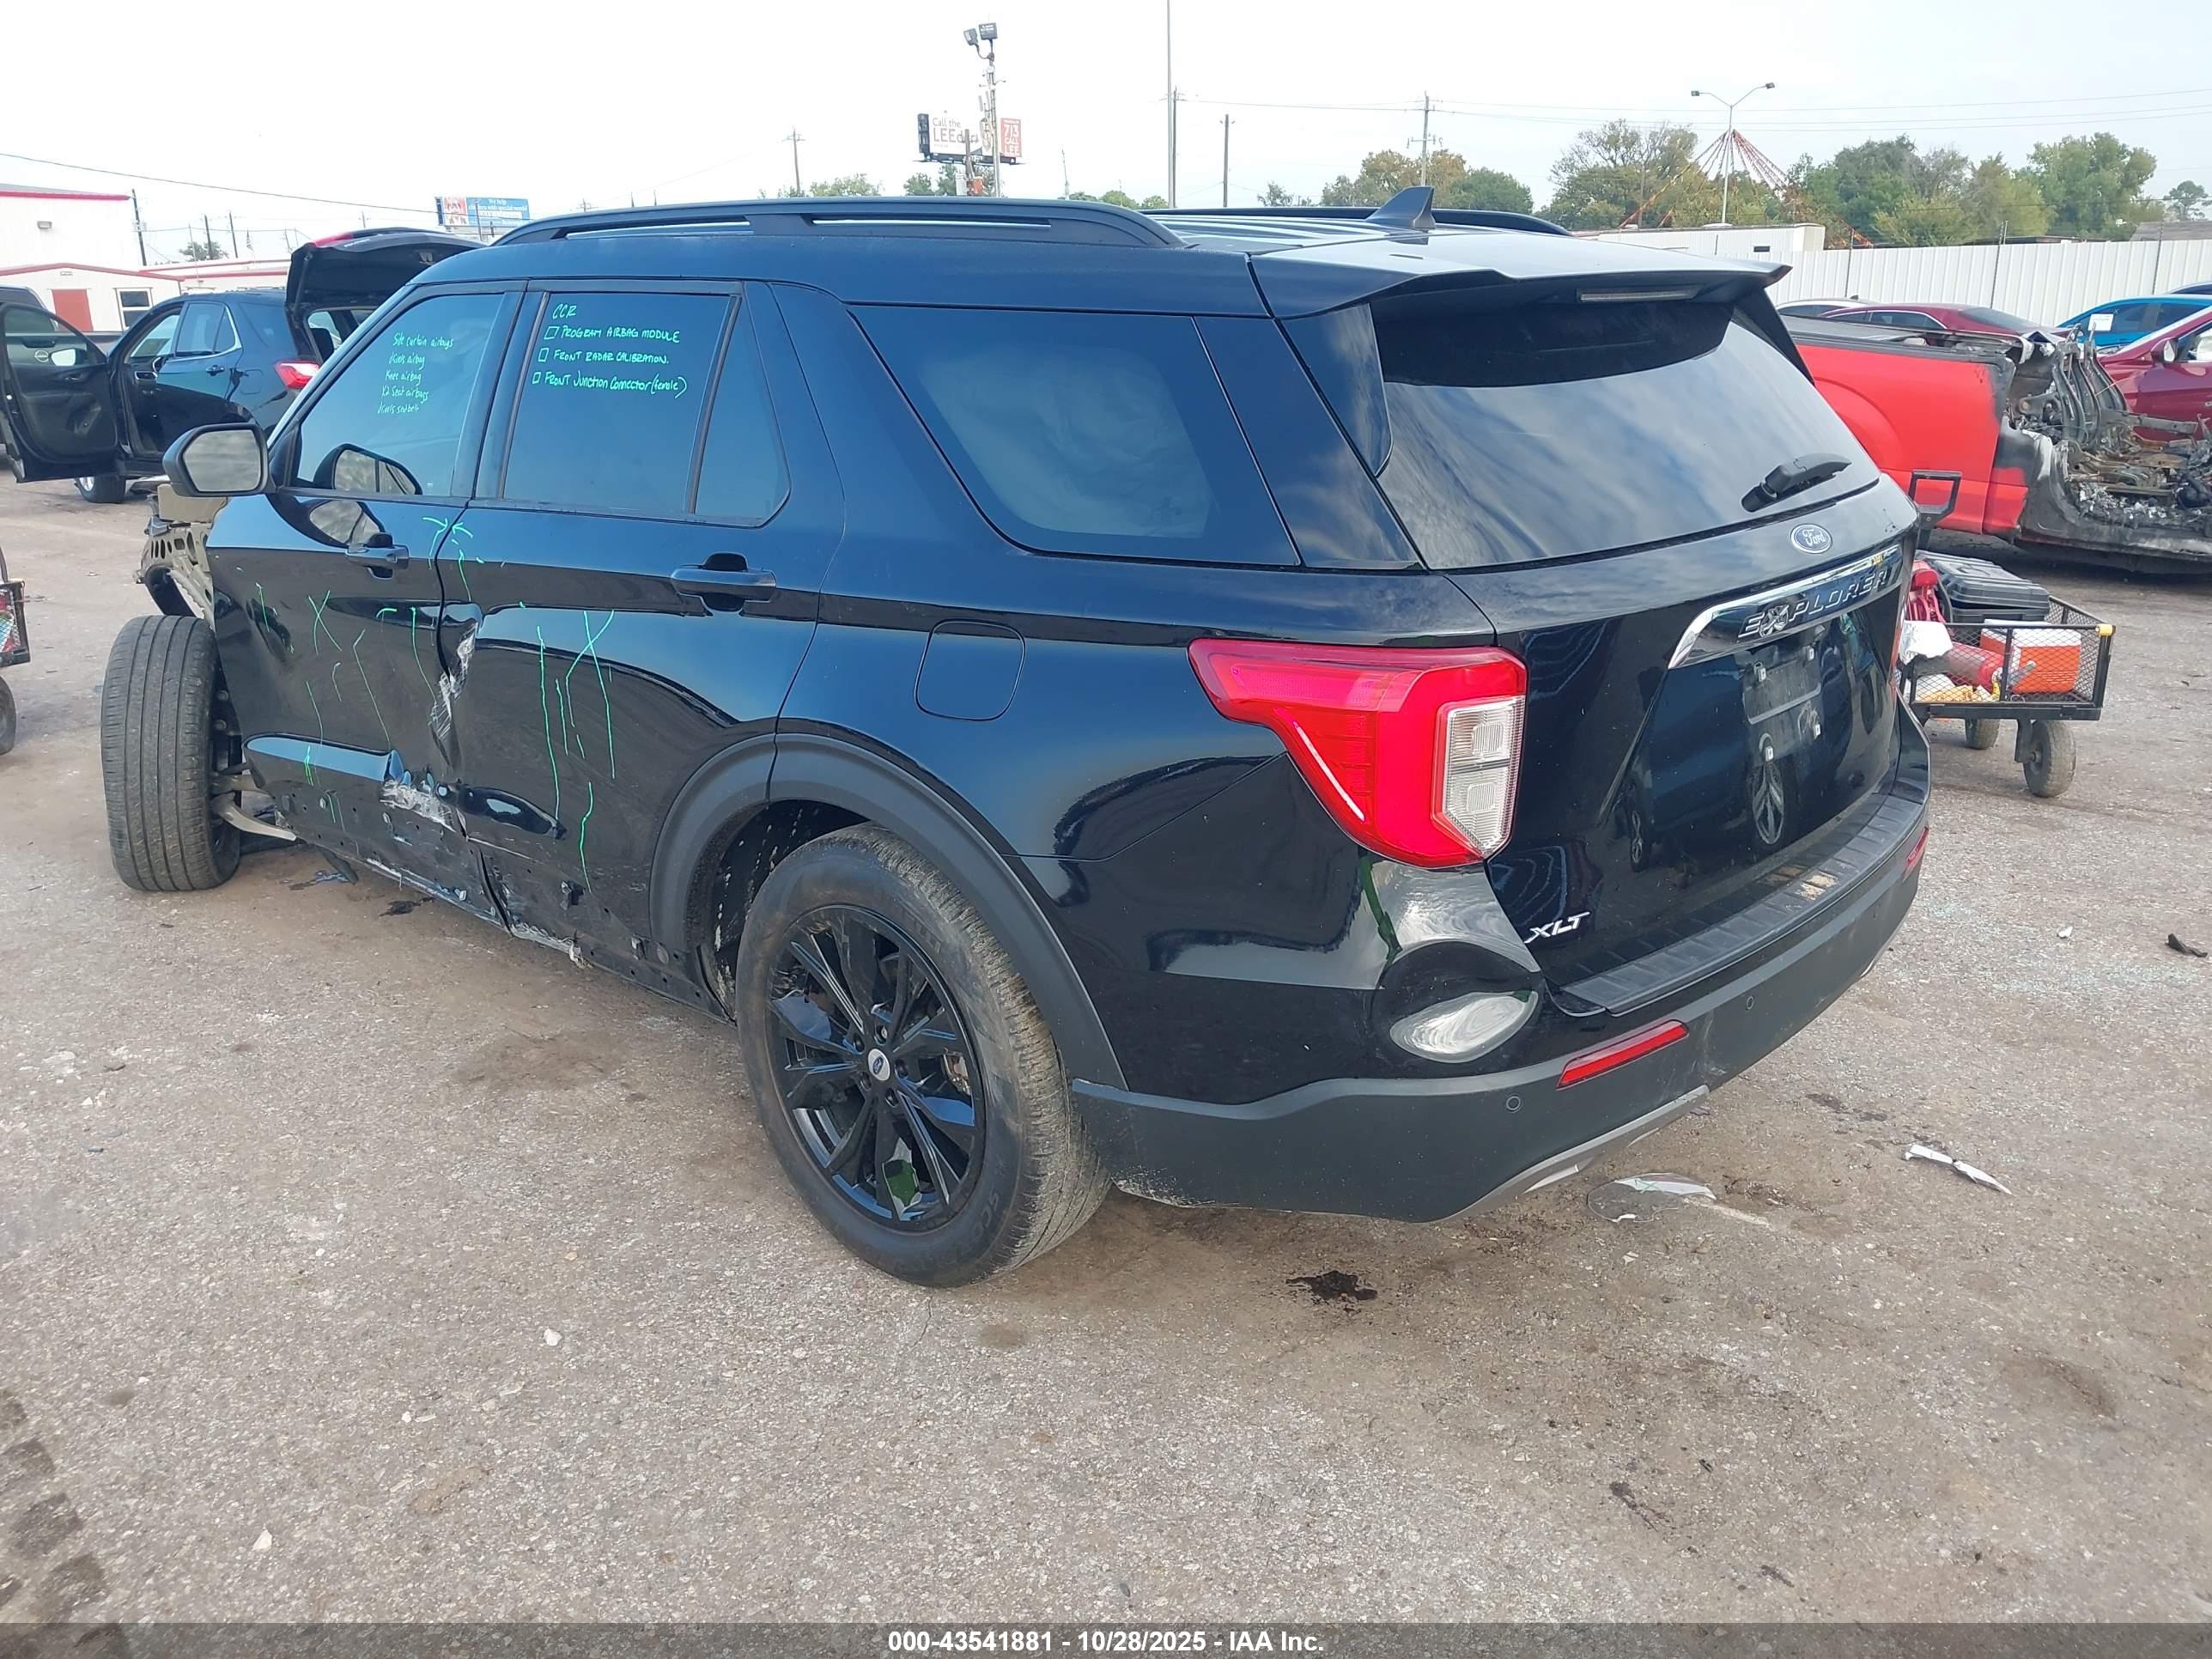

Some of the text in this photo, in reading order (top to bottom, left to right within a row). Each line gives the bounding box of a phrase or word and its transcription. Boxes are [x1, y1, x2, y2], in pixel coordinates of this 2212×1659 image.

[1004, 124, 1019, 137] 713
[1004, 144, 1020, 155] LEE
[552, 303, 577, 319] CCR
[561, 325, 680, 343] PROGRAM AIRBAG MODULE
[554, 349, 582, 361] FRONT
[585, 351, 614, 362] RADAR
[544, 371, 571, 386] FRONT
[1802, 528, 1826, 546] Ford
[1738, 569, 1887, 638] EXPLORER
[1523, 911, 1590, 944] XLT
